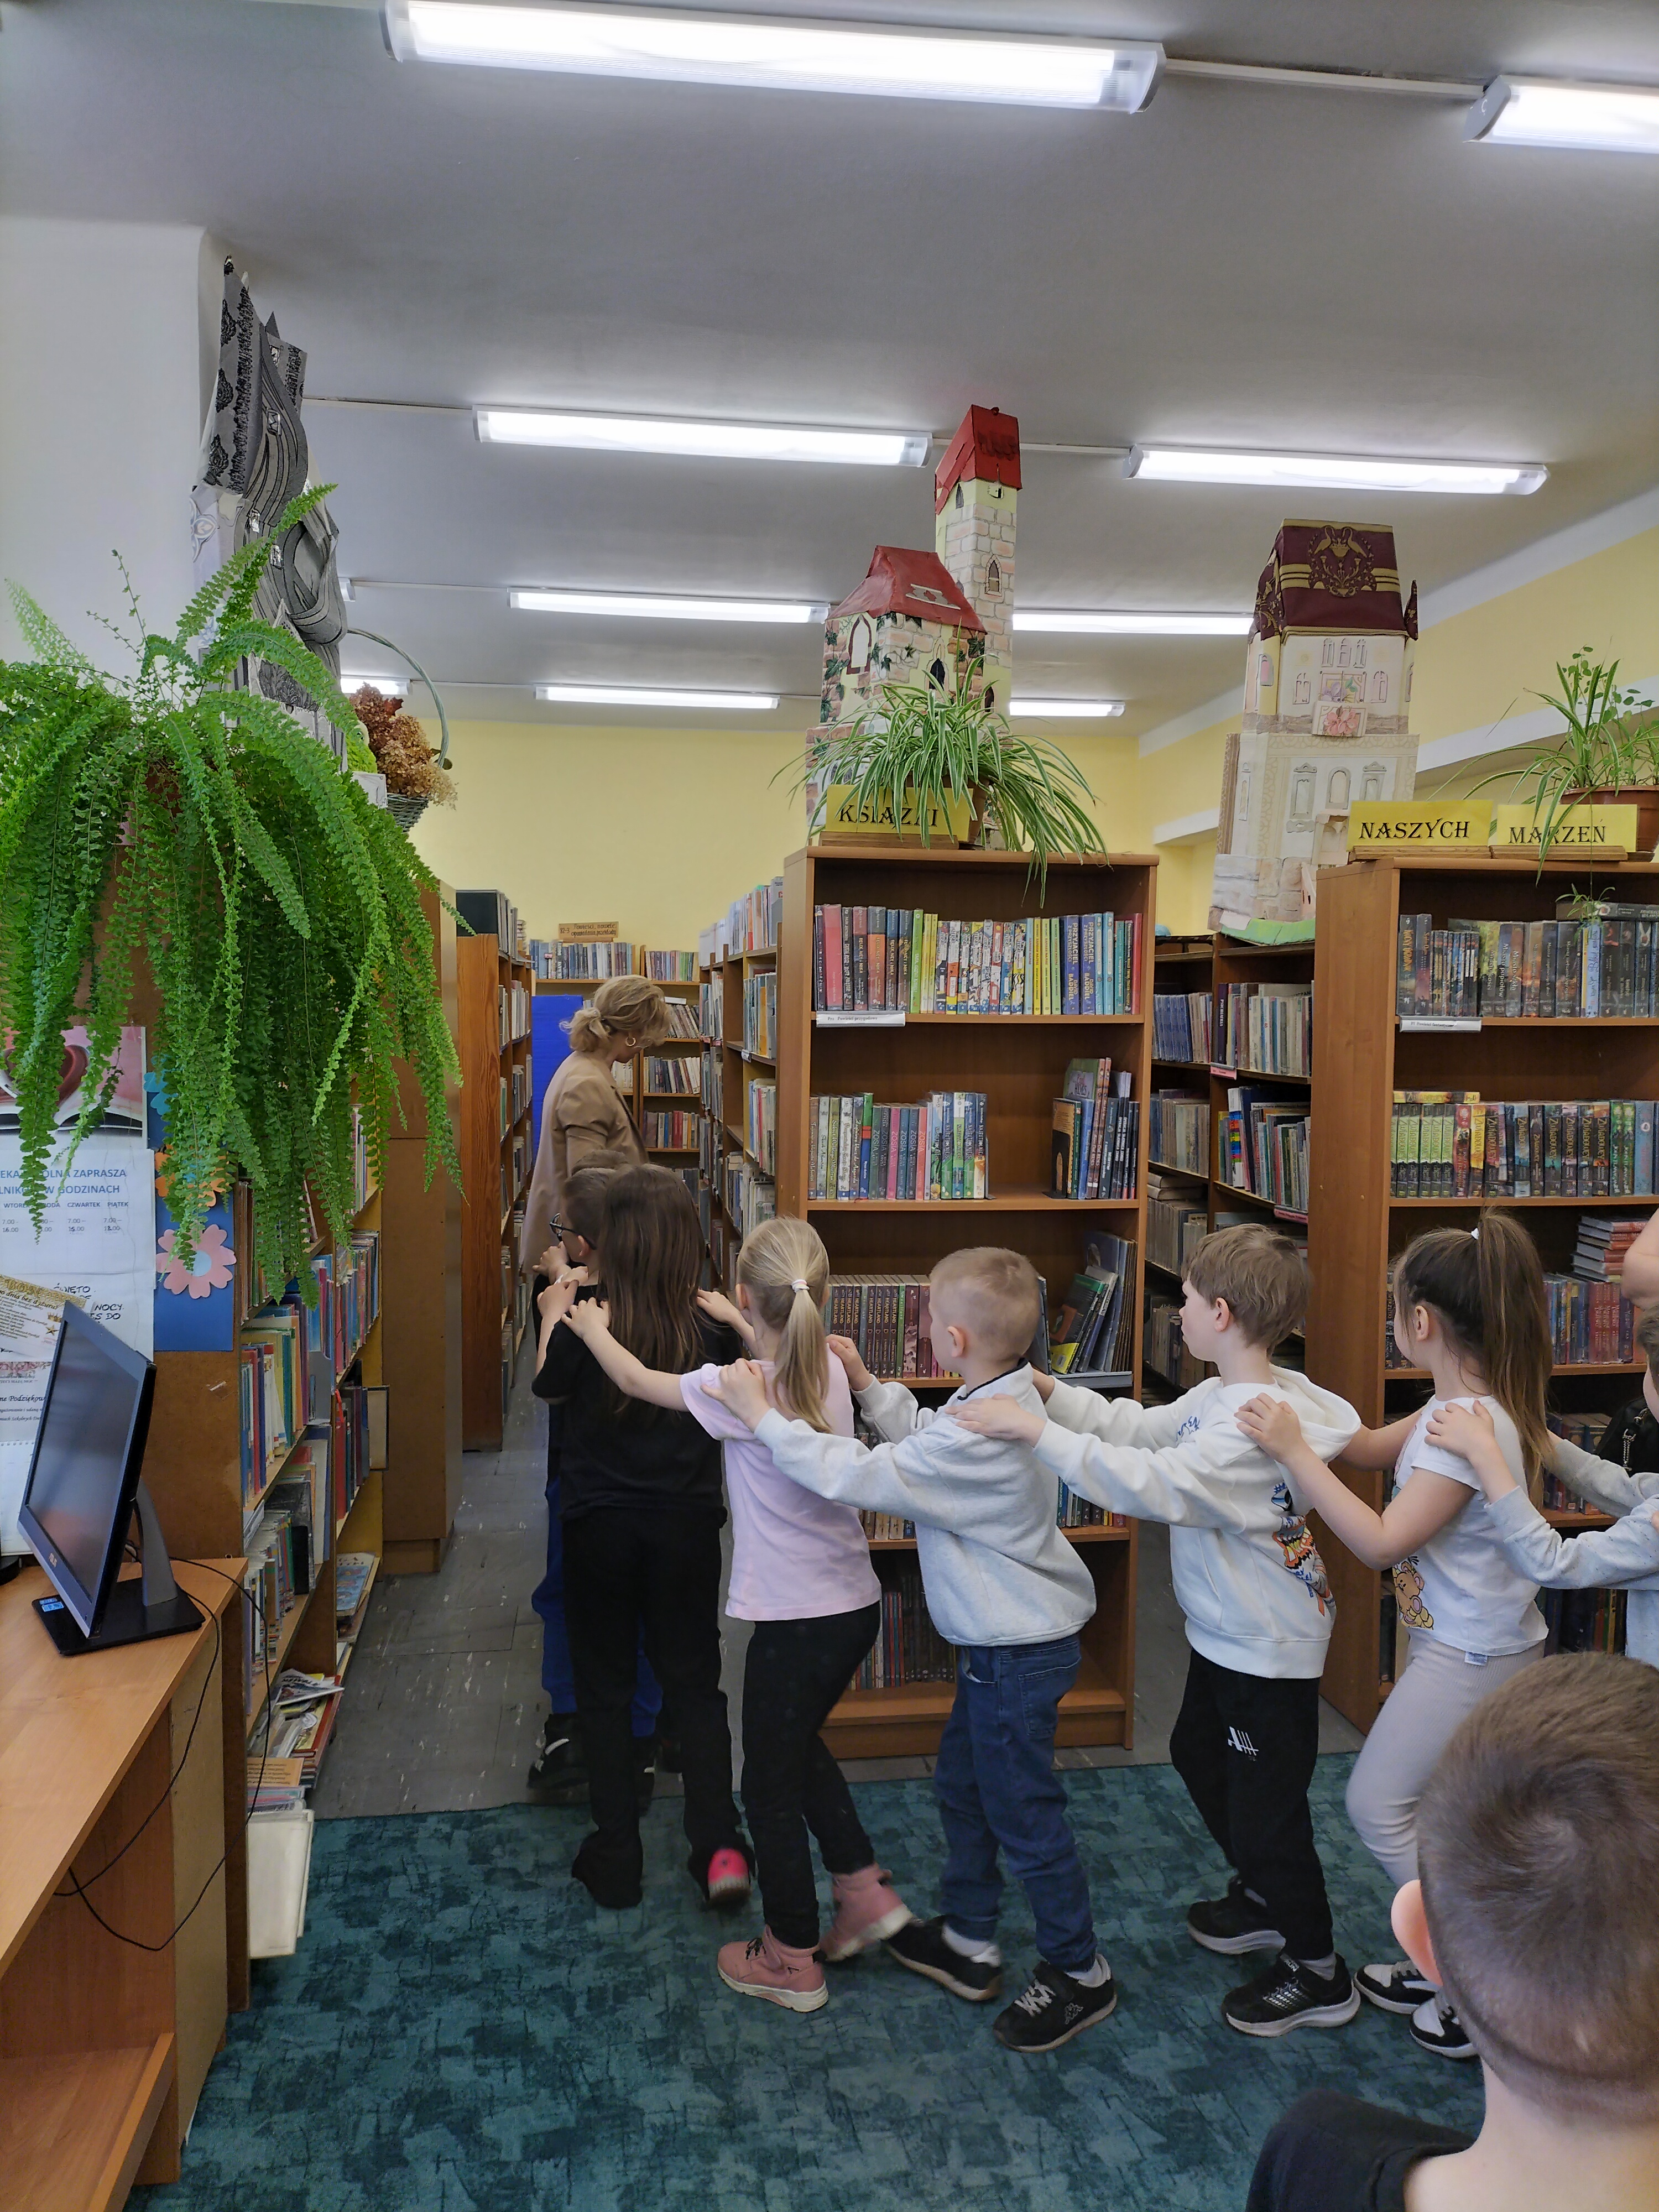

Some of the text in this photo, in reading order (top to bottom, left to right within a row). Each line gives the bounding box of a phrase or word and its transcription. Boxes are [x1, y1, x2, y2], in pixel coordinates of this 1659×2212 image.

[839, 805, 938, 830] KSIĄŻI
[1359, 818, 1470, 839] NASZYCH
[1509, 818, 1606, 844] MARZEŃ
[1402, 930, 1413, 972] NOCNY OGRODNIK
[1549, 1118, 1558, 1159] ZWIADOWCY
[1566, 1118, 1575, 1159] ZWIADOWCY
[1582, 1118, 1592, 1159] ZWIADOWCY
[1598, 1118, 1606, 1159] ZWIADOWCY
[74, 1170, 126, 1178] ZAPRASZA
[60, 1185, 119, 1193] GODZINACH
[54, 1283, 91, 1294] IĘTO
